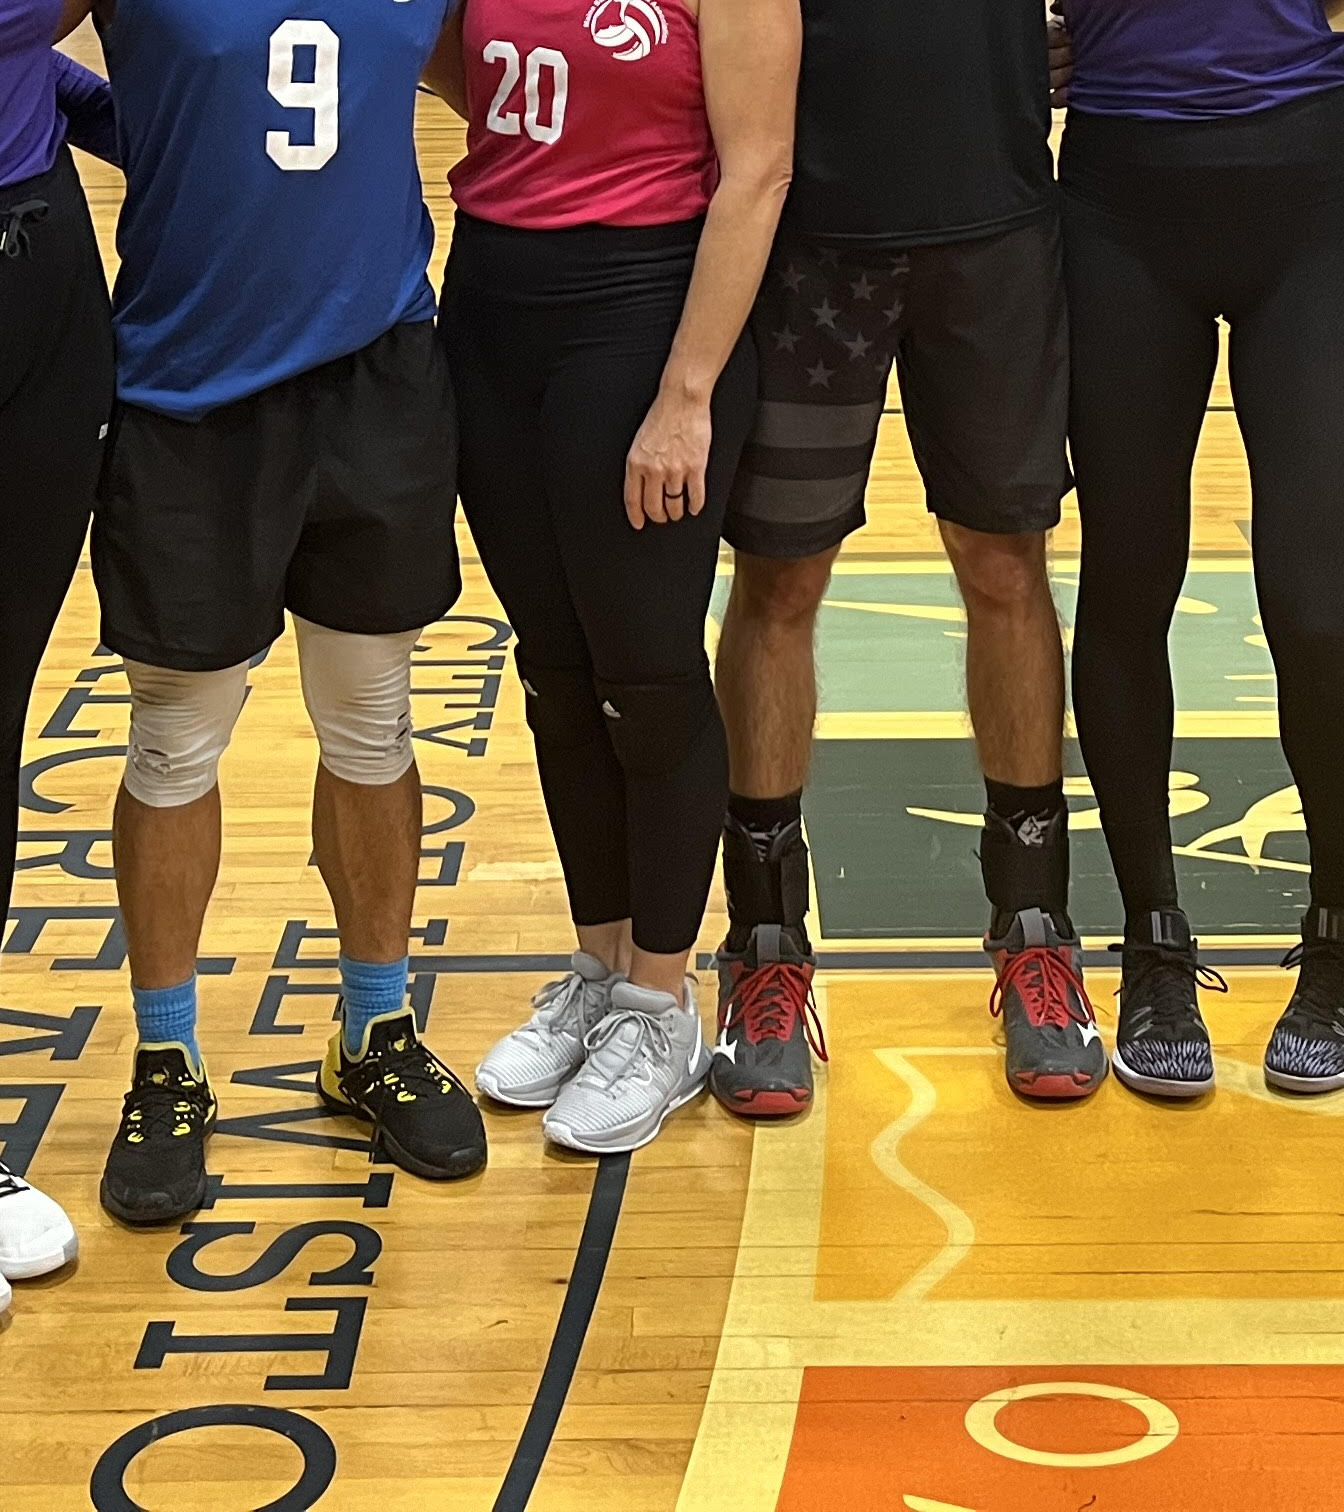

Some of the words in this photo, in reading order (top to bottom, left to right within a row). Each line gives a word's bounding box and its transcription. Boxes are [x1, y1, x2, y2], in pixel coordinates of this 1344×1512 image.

[266, 19, 340, 171] 9
[482, 40, 569, 146] 20
[410, 615, 514, 757] CITY
